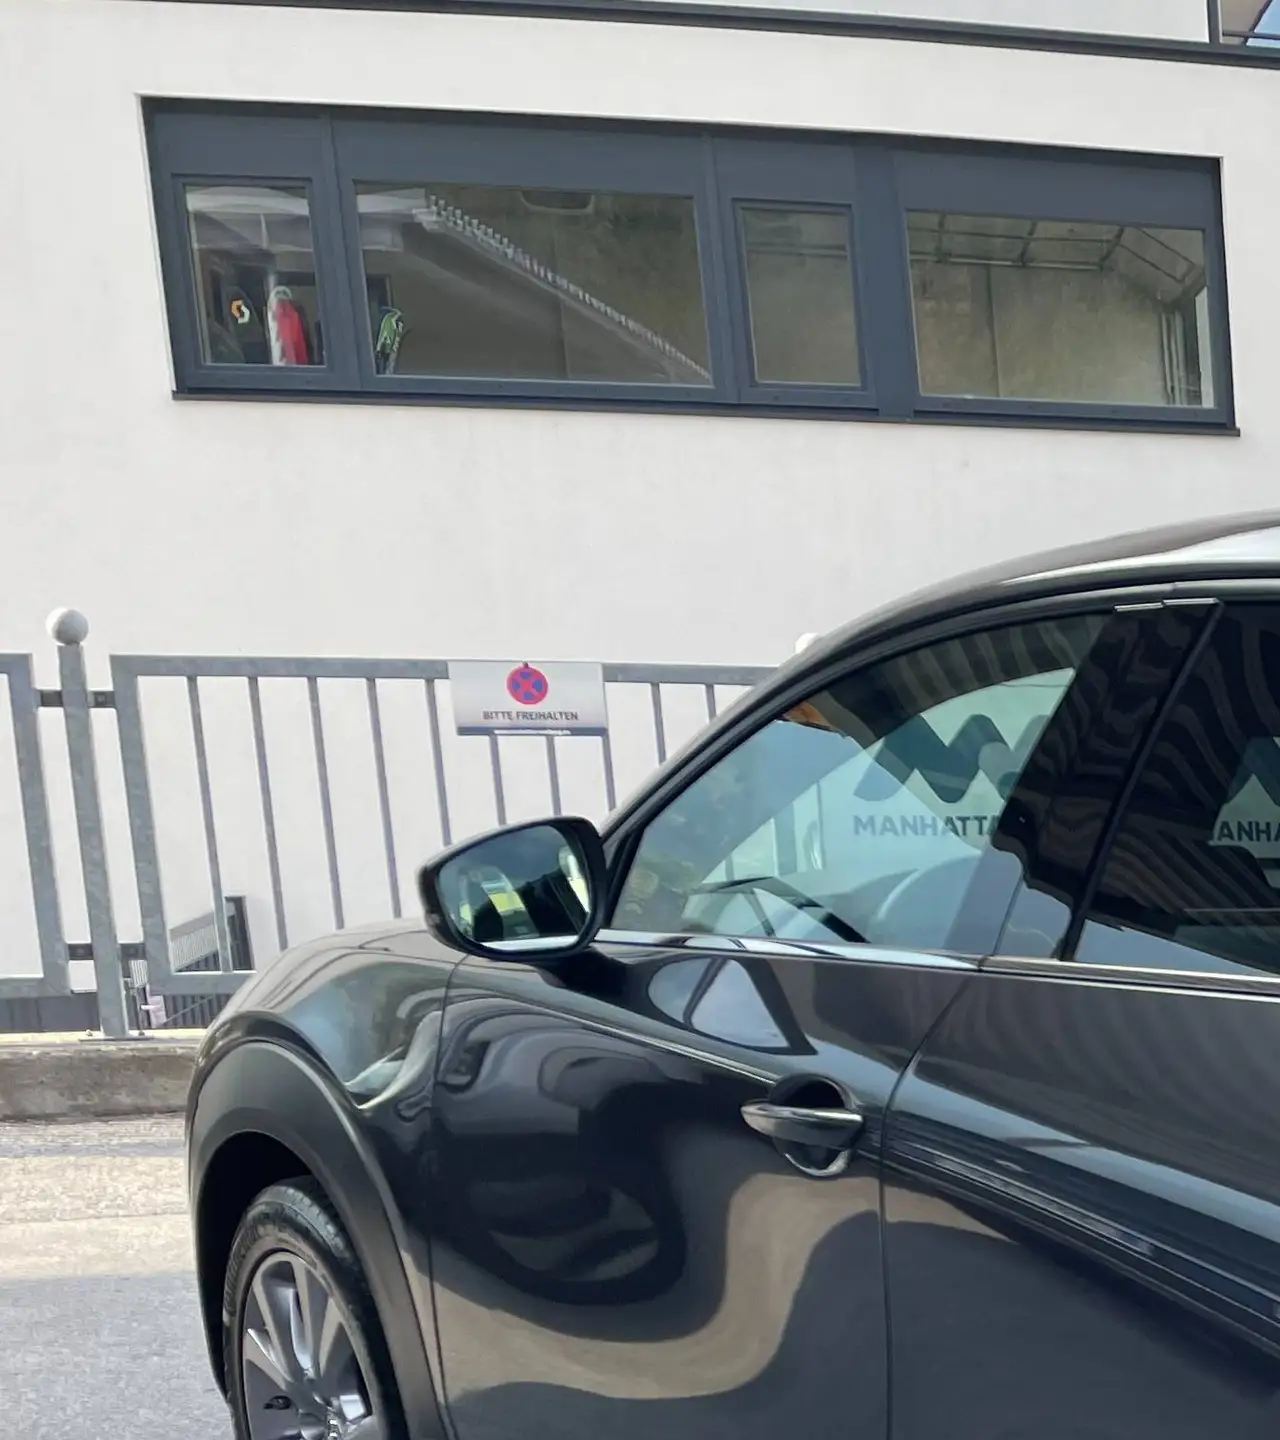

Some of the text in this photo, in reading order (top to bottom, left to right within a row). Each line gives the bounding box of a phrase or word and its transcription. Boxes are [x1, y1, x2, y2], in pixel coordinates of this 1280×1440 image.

[482, 711, 579, 721] BITTE FREIHALTEN
[852, 814, 1001, 837] MANHATT
